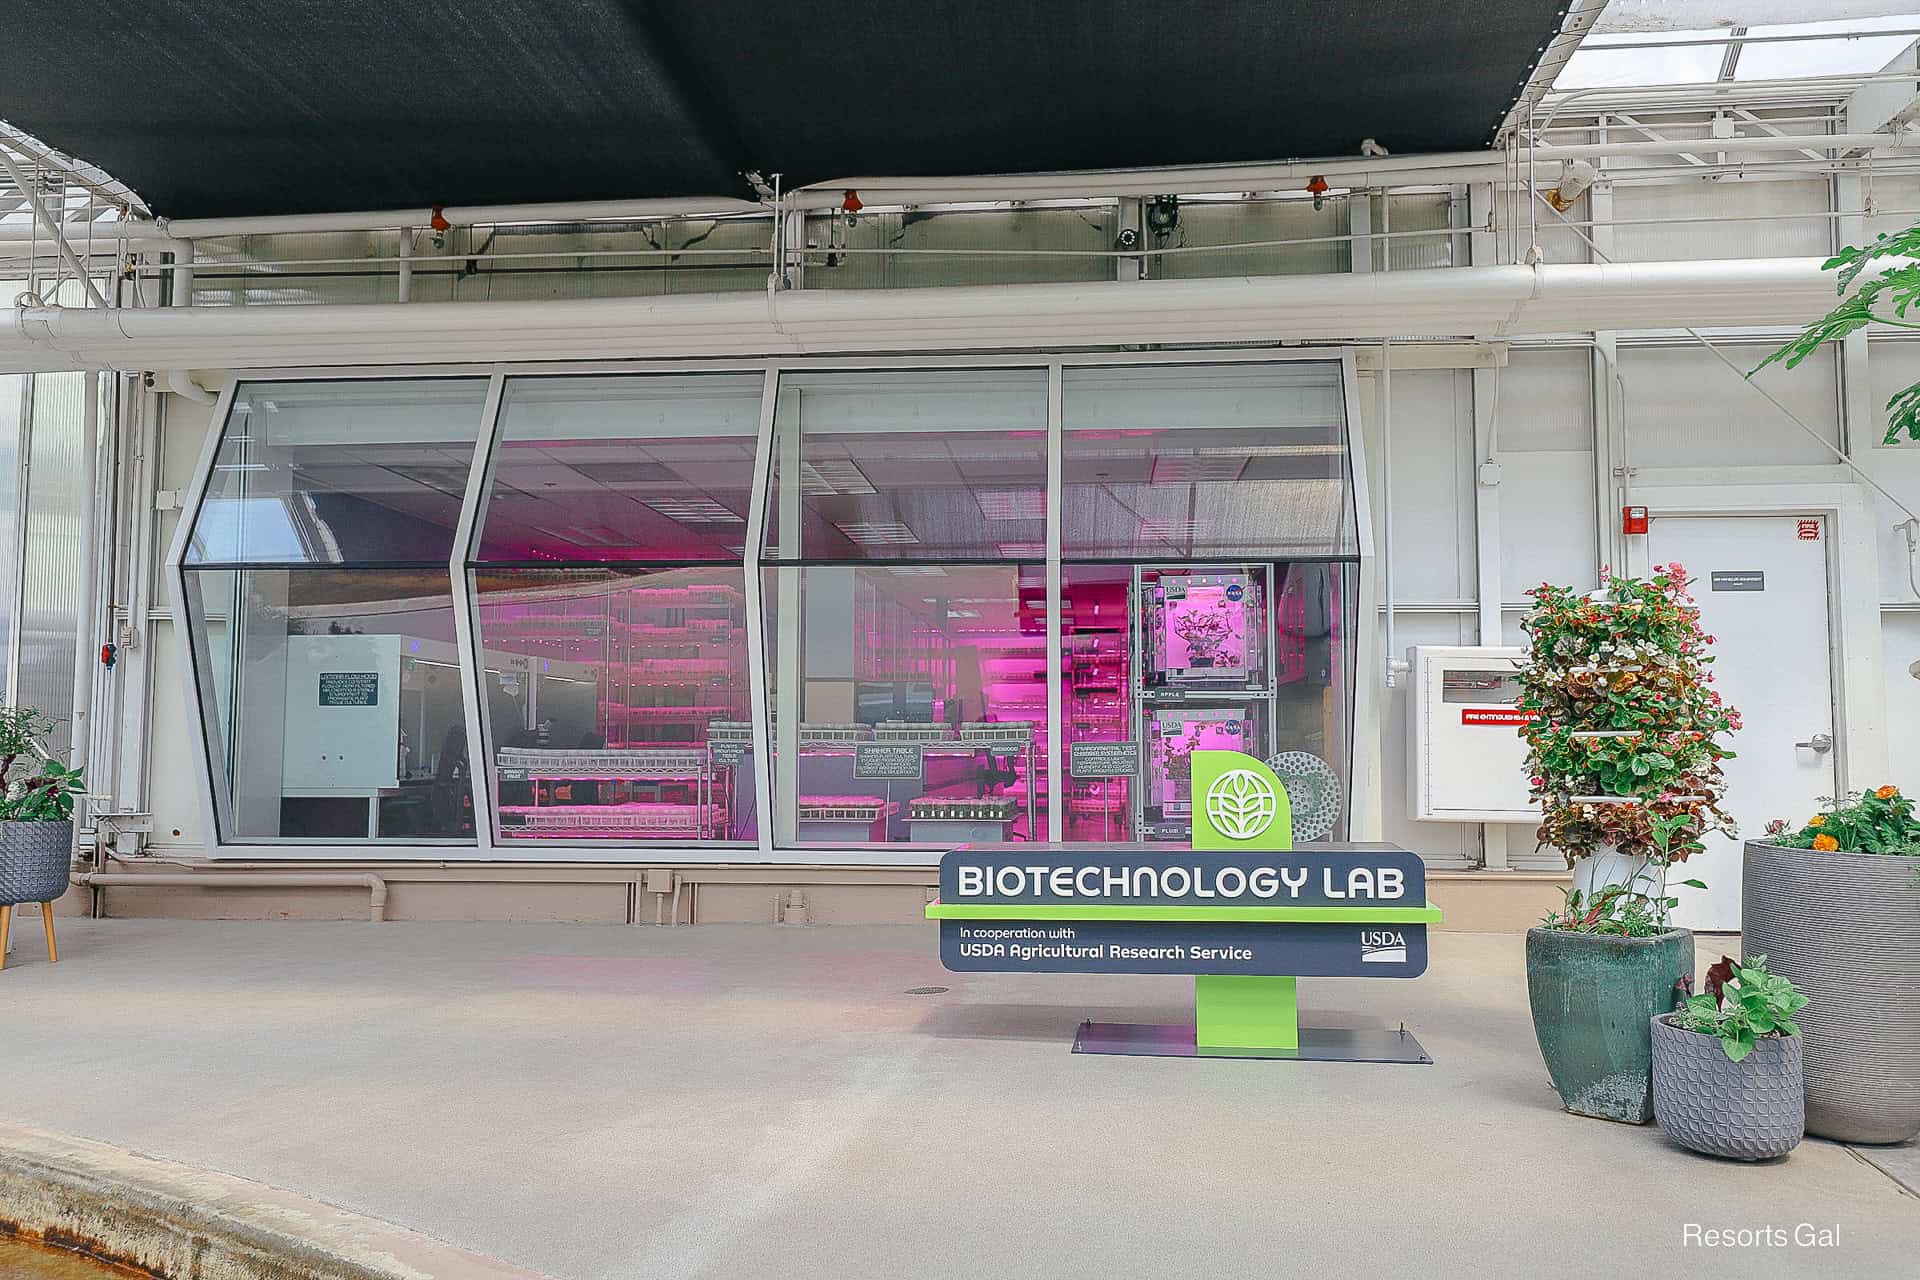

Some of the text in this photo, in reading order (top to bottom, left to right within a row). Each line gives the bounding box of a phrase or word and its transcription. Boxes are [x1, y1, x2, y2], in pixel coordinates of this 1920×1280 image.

[1162, 721, 1182, 729] USDA
[958, 866, 1405, 899] BIOTECHNOLOGY LAB
[960, 927, 1076, 940] In cooperation with
[1361, 931, 1407, 946] USDA
[960, 943, 1253, 961] USDA Agricultural Research Service
